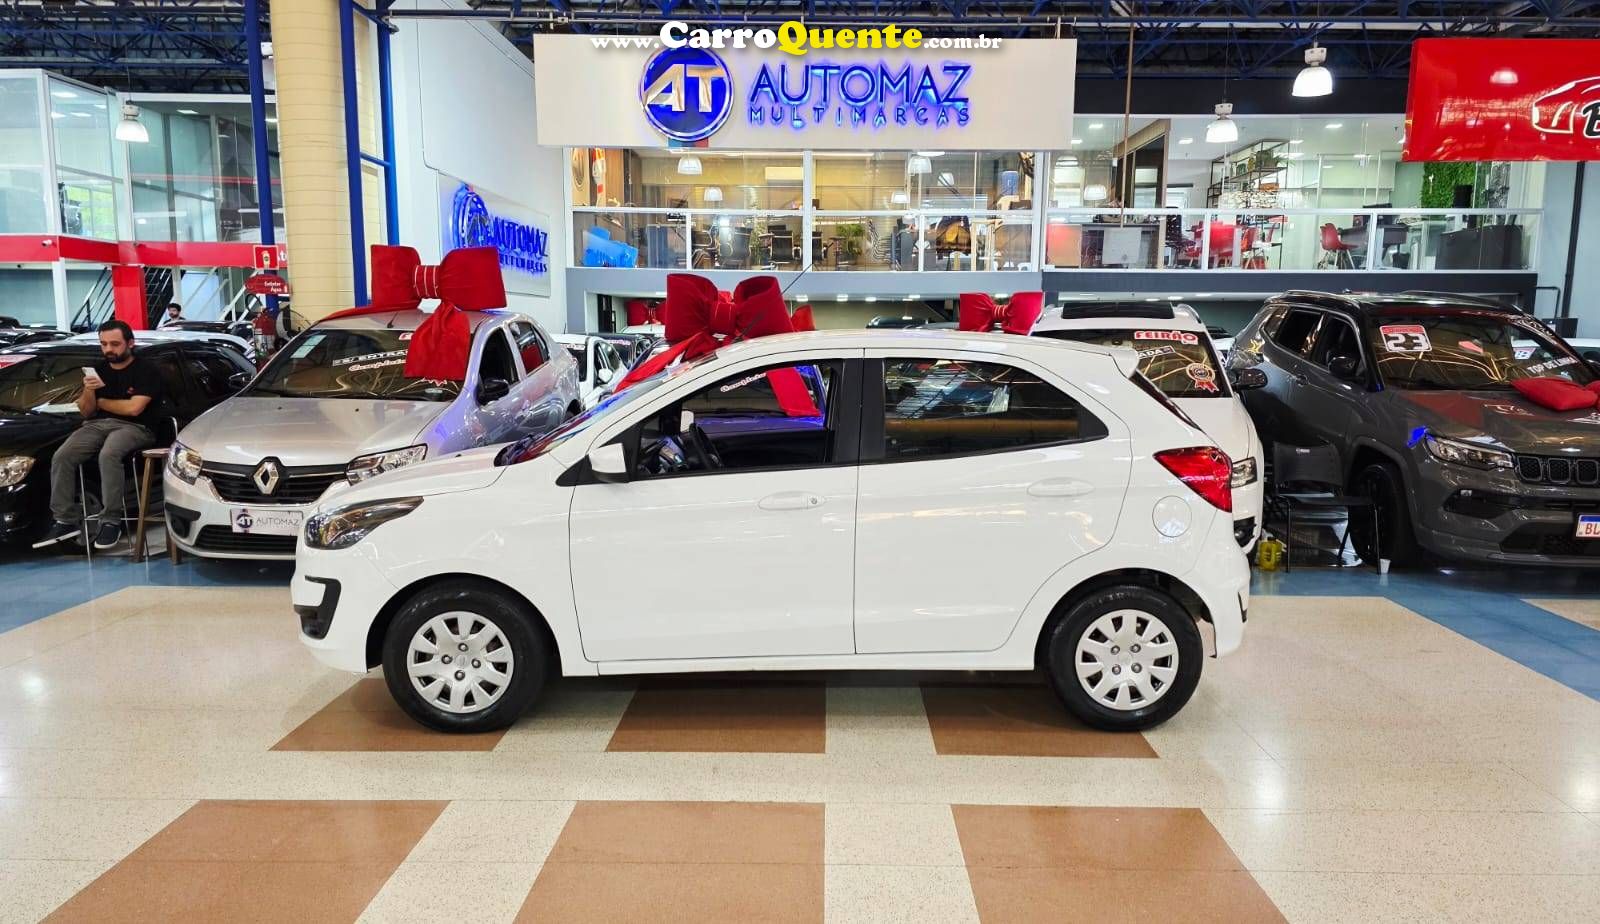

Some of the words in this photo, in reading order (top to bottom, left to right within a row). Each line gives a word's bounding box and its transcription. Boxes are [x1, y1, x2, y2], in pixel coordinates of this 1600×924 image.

[750, 64, 972, 105] AUTOMAZ
[750, 106, 970, 125] MULTIMARCAS
[1134, 331, 1198, 343] FEIRÃO
[1387, 333, 1429, 351] 23
[256, 517, 299, 526] AUTOMAZ
